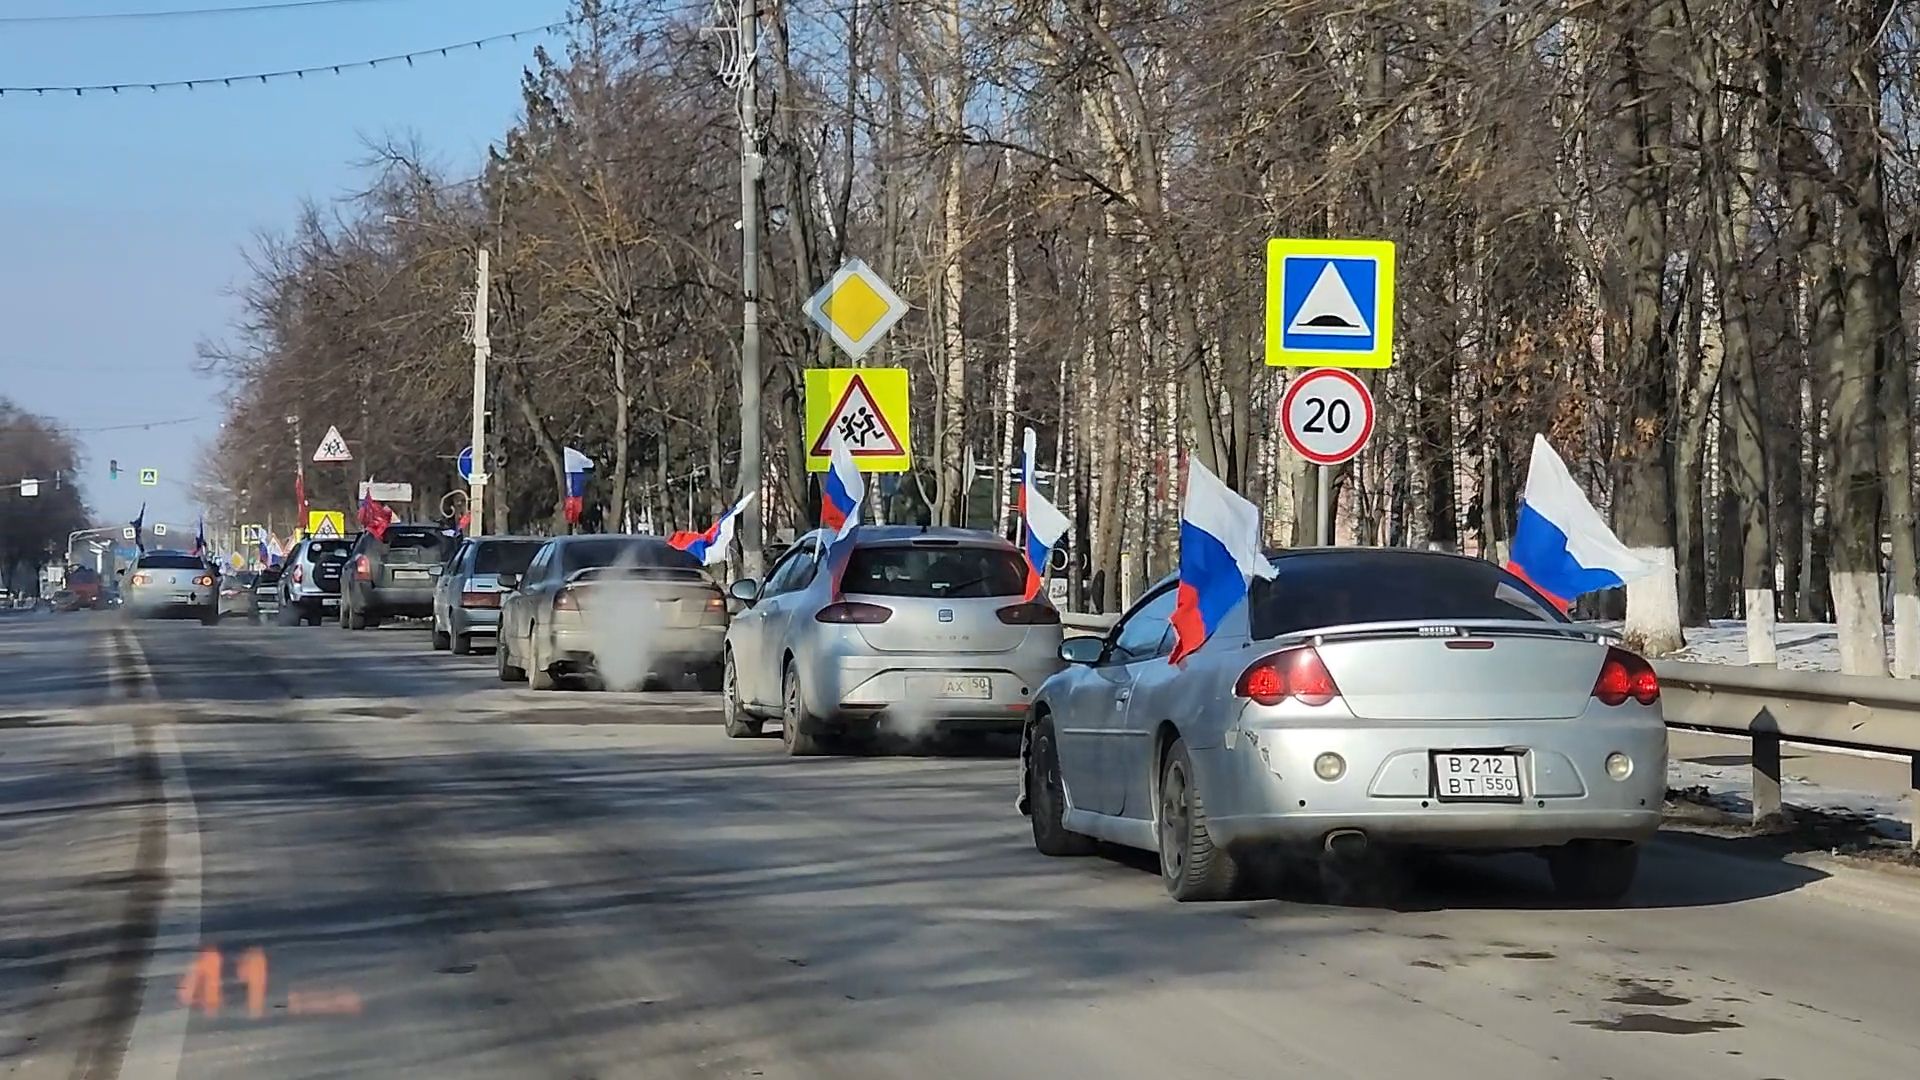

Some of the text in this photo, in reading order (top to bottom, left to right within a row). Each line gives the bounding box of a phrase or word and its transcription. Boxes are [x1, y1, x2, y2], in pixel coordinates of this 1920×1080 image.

[1303, 397, 1351, 434] 20
[972, 679, 987, 689] 50
[1449, 757, 1504, 774] В 212
[1448, 777, 1514, 794] ВТ 550
[177, 946, 267, 1017] 41
